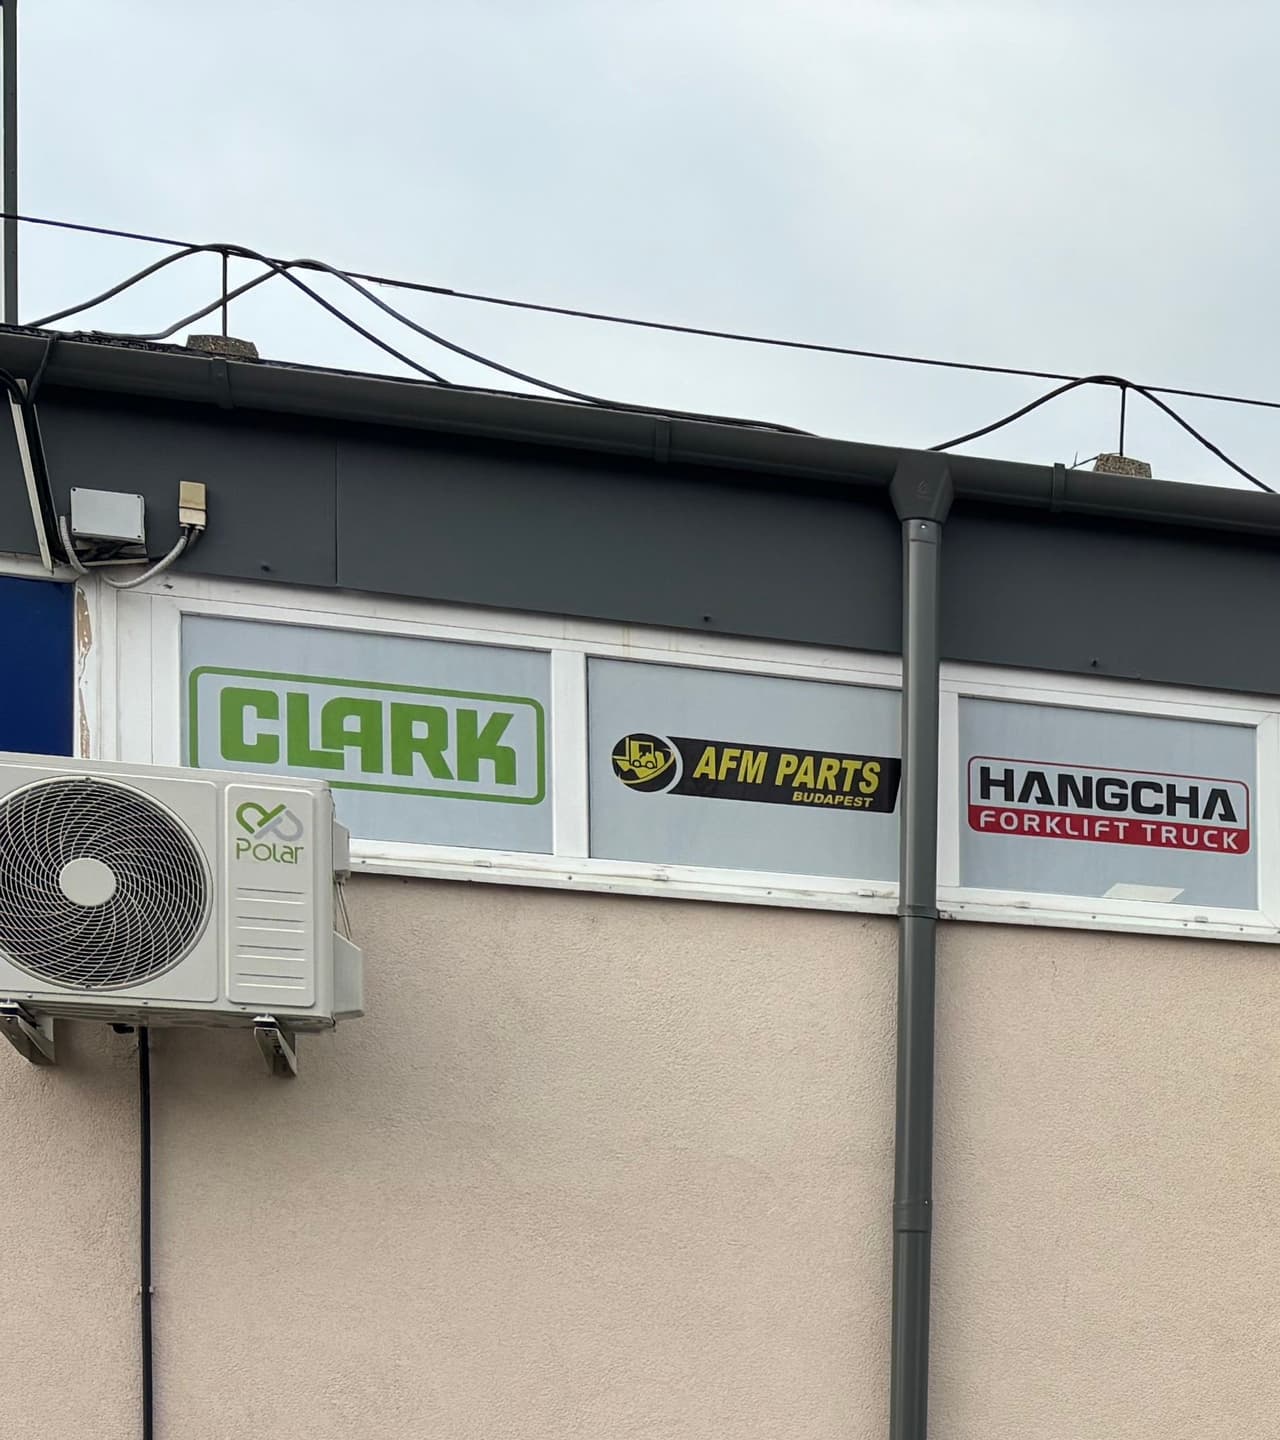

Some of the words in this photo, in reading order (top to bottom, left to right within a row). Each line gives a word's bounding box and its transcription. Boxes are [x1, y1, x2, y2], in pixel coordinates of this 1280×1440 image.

[220, 686, 517, 786] CLARK
[693, 743, 770, 783] AFM
[776, 752, 881, 794] PARTS
[792, 790, 874, 808] BUDAPEST
[979, 765, 1238, 824] HANGCHA
[235, 839, 304, 865] Polar
[979, 810, 1128, 840] FORKLIFT
[1141, 824, 1240, 850] TRUCK
